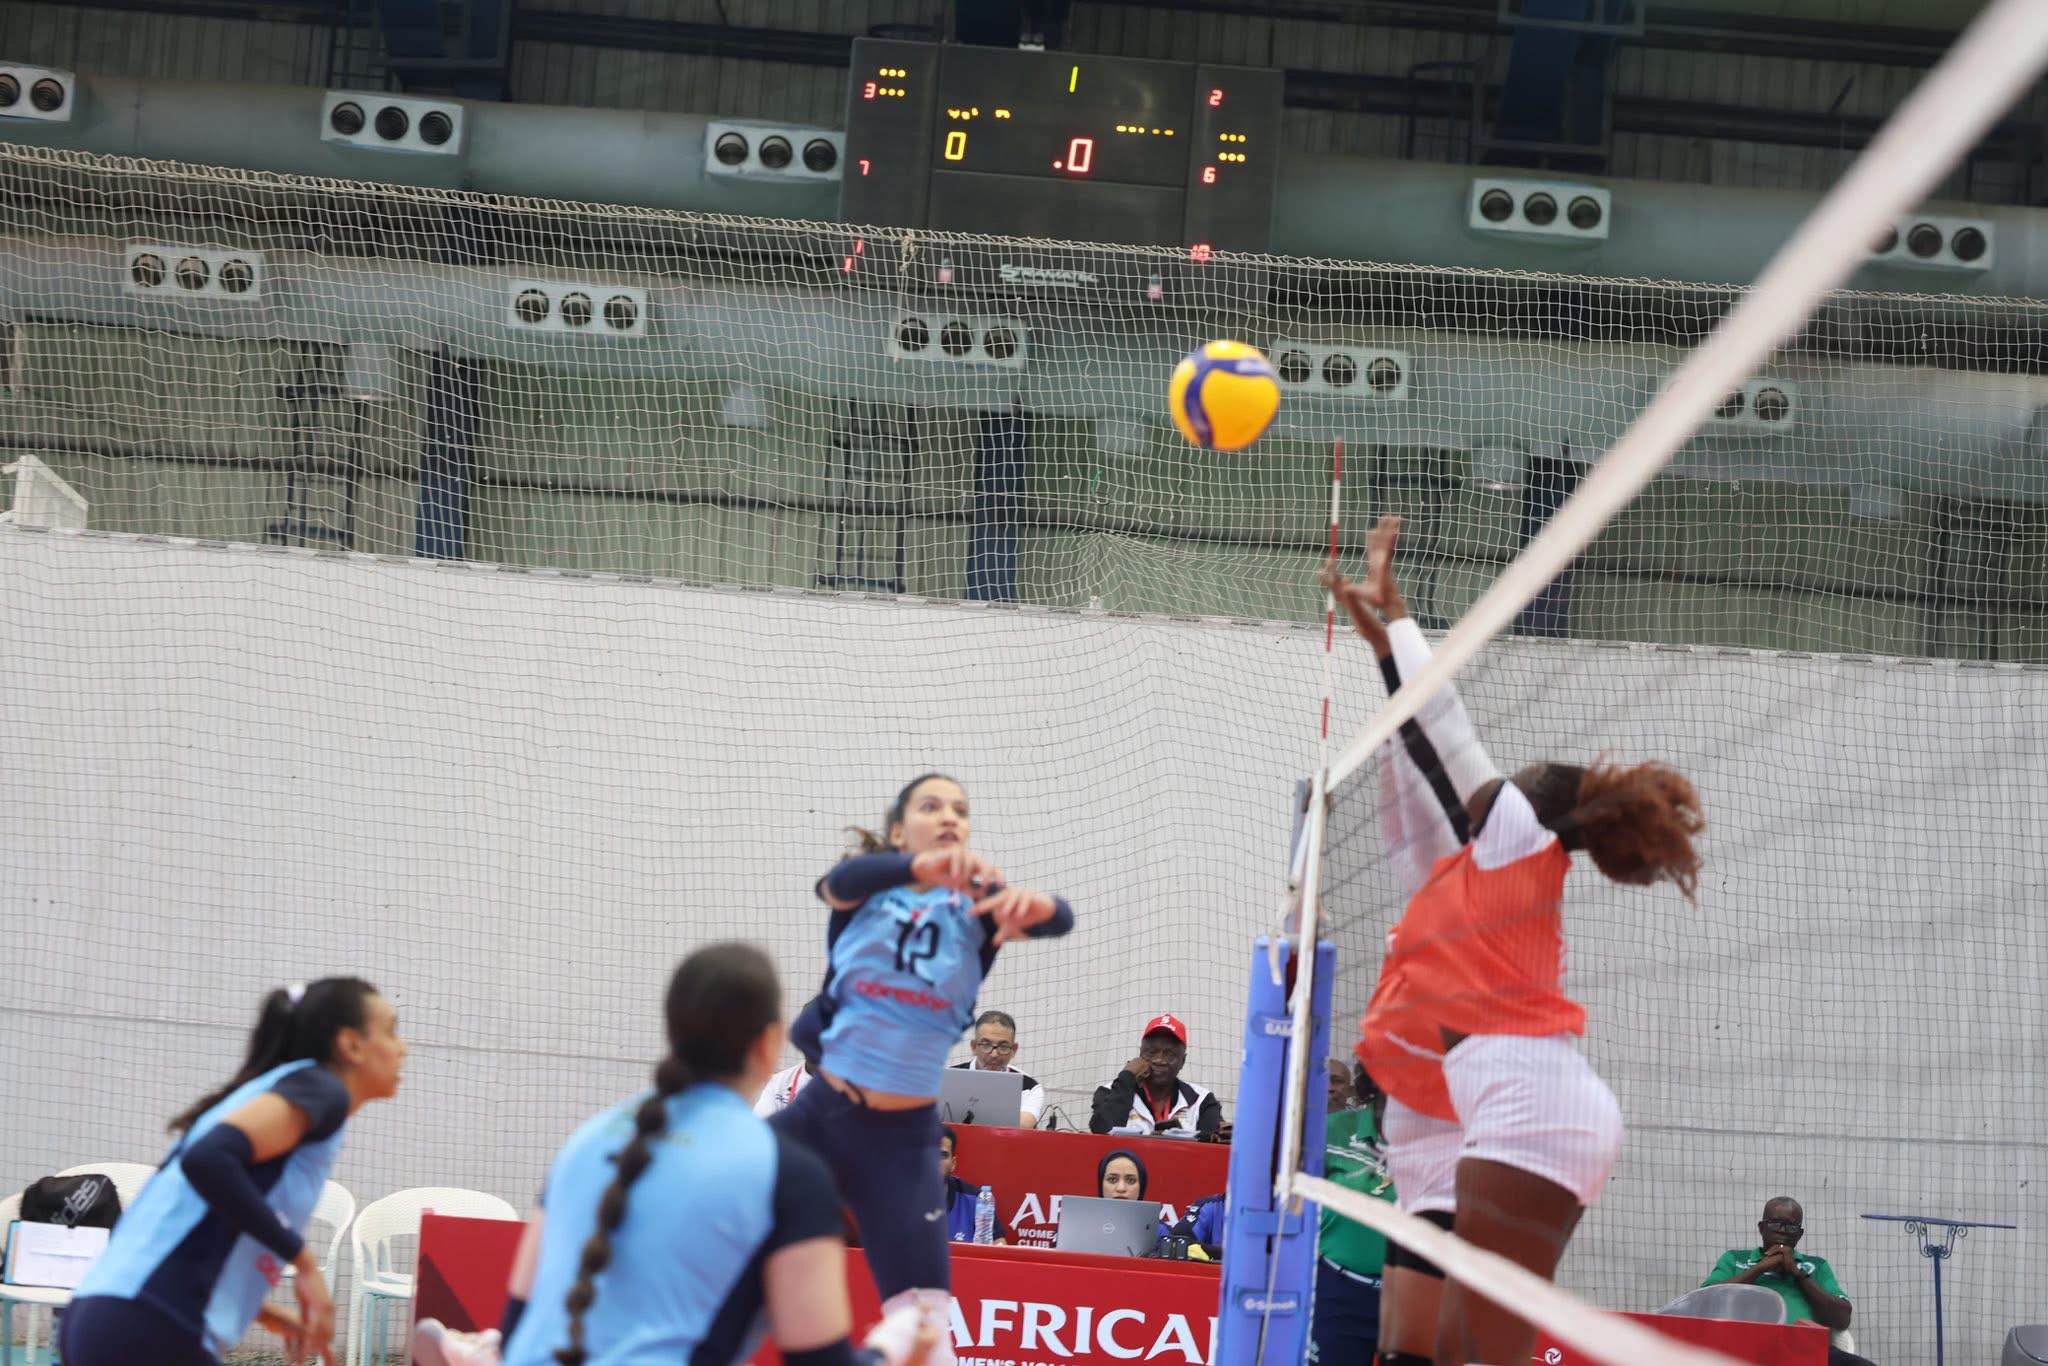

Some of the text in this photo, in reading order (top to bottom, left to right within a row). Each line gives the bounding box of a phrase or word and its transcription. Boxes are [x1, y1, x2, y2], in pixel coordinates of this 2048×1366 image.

[863, 83, 876, 98] 3
[1208, 89, 1222, 106] 2
[945, 131, 967, 161] 0
[859, 160, 871, 176] 7
[1202, 167, 1217, 184] 6
